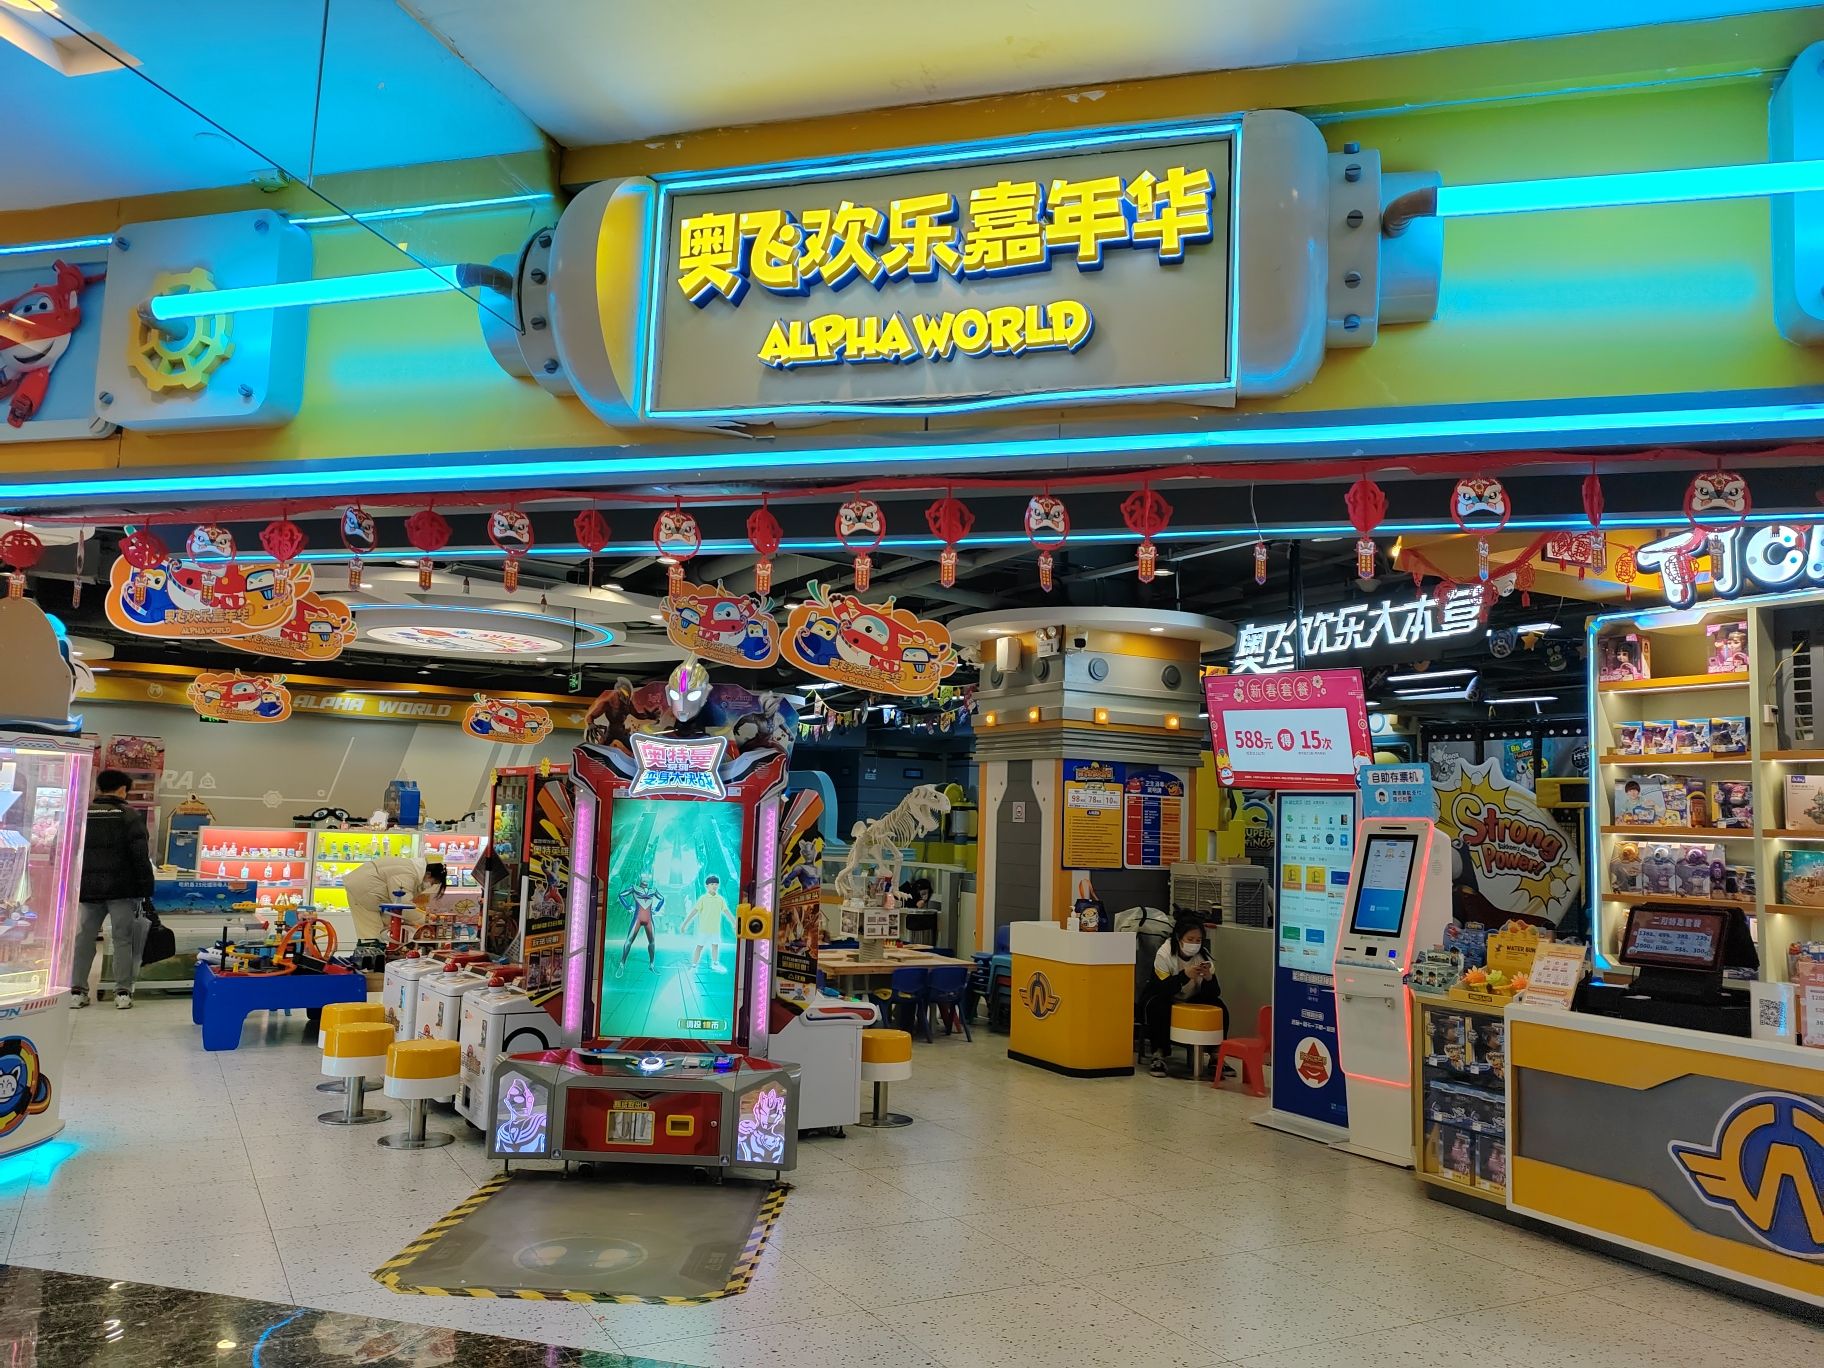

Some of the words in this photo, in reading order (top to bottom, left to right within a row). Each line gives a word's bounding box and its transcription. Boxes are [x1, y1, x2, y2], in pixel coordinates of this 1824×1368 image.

[678, 166, 1216, 308] 奥飞欢乐嘉年华
[758, 311, 916, 371] ALPHA
[914, 300, 1094, 365] WORLD
[1637, 525, 1824, 604] TIC
[164, 609, 249, 625] 奥飞欢乐嘉年华
[1230, 586, 1483, 674] 奥飞欢乐大本营
[1250, 681, 1309, 699] 新春套餐
[294, 695, 364, 712] ALPHA
[379, 700, 453, 717] WORLD
[1234, 730, 1274, 750] 588元
[1300, 730, 1333, 751] 15次
[642, 743, 713, 769] 奥特曼
[641, 770, 714, 790] 变身大决战
[1372, 771, 1419, 783] 自助存票机
[1456, 797, 1563, 863] Strong
[1481, 843, 1547, 876] Power!
[1506, 945, 1525, 953] WATER
